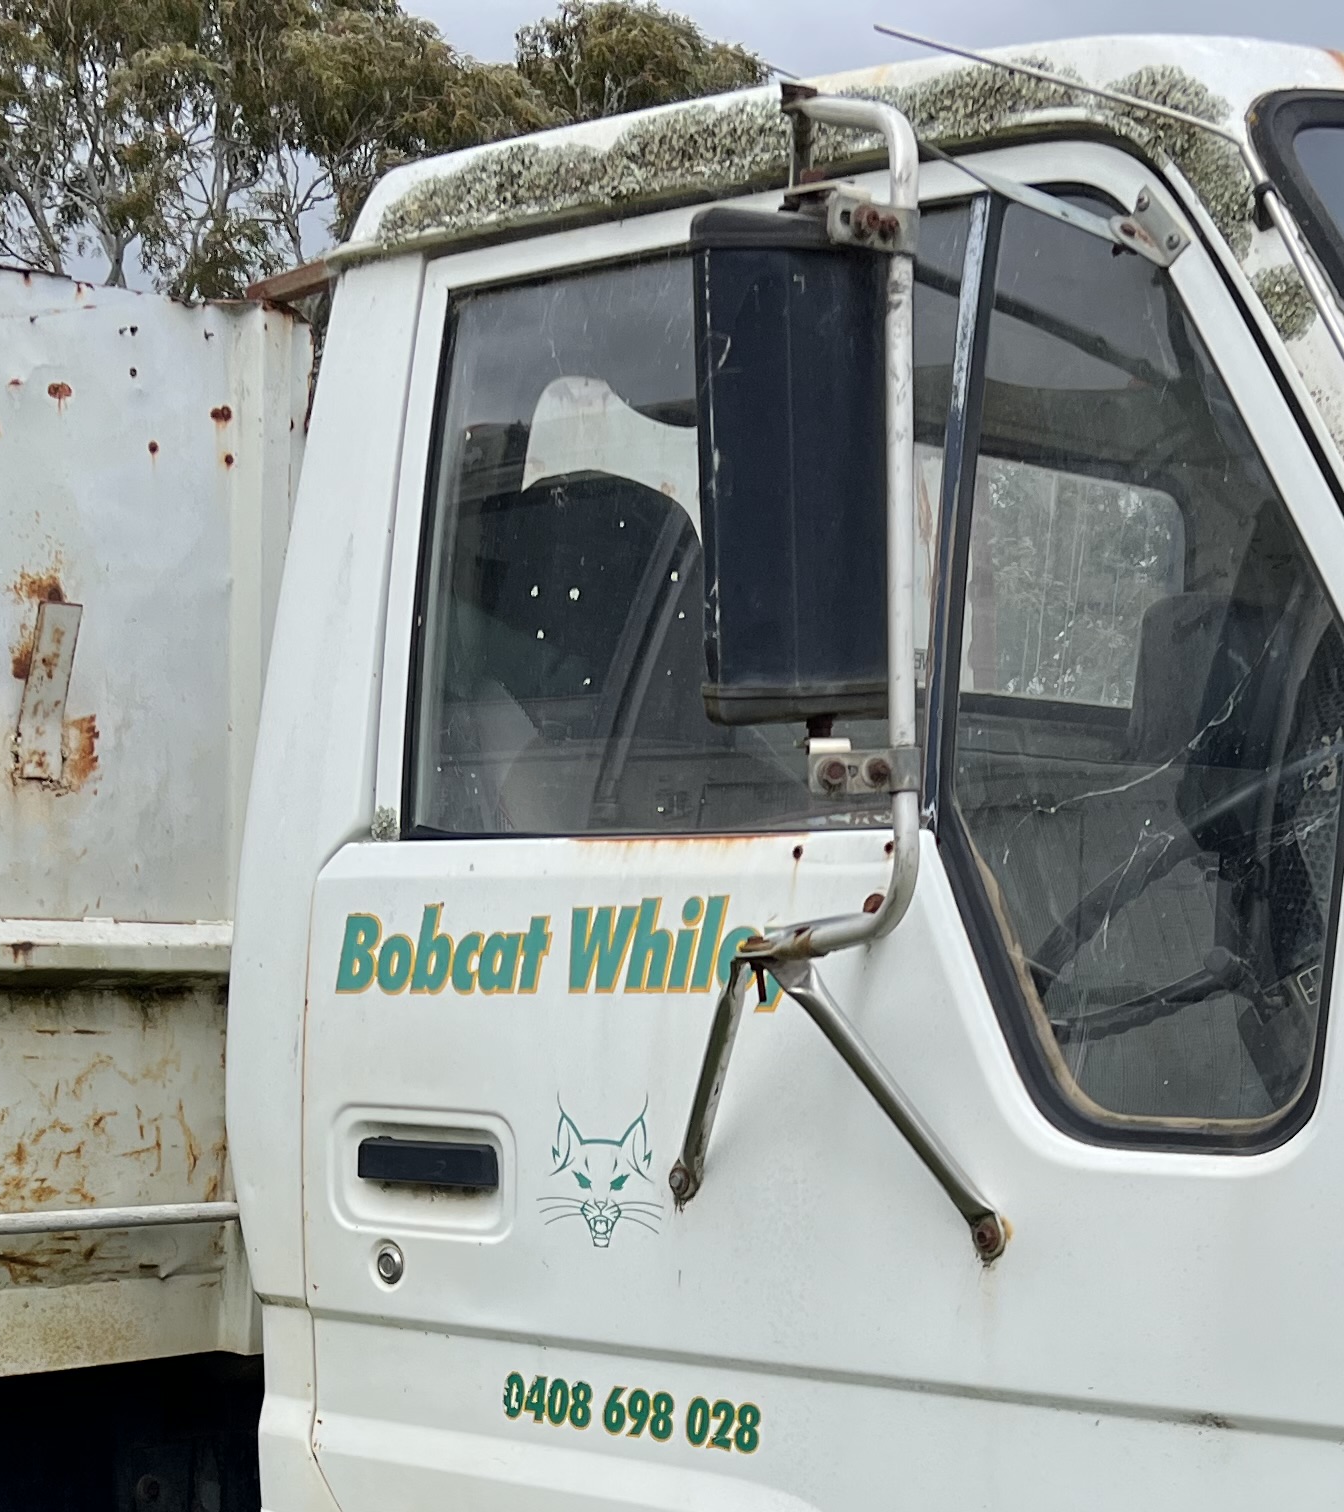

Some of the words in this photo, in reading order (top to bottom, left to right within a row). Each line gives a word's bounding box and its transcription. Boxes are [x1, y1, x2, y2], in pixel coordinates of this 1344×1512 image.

[336, 902, 551, 995] Bobcat
[503, 1371, 593, 1430] 0408
[603, 1385, 675, 1443] 698
[685, 1395, 761, 1454] 028
